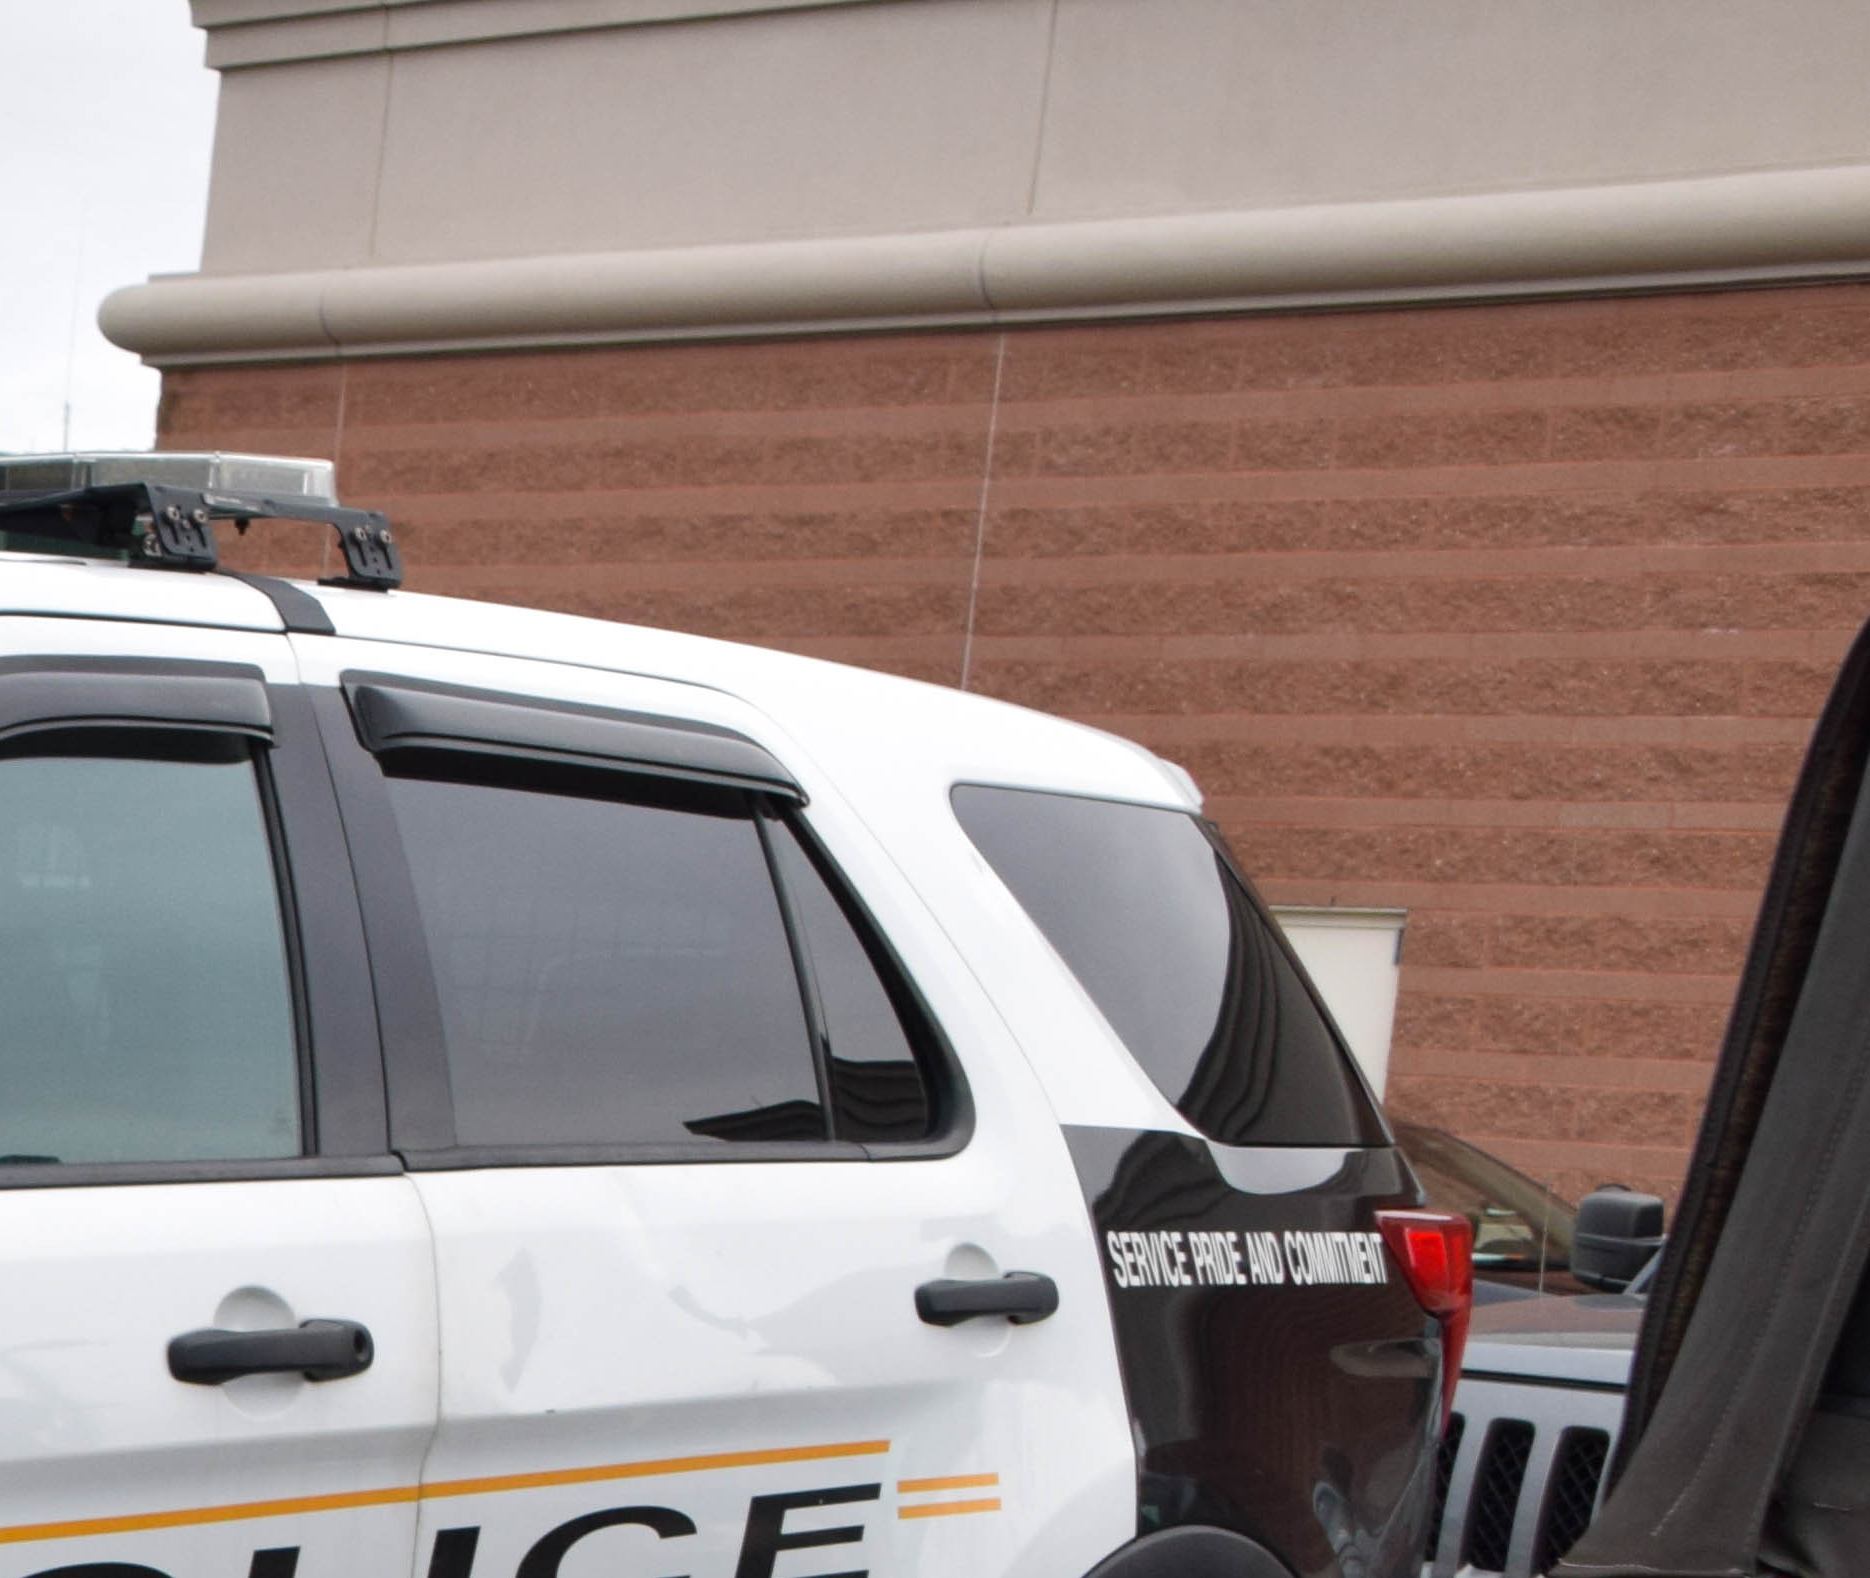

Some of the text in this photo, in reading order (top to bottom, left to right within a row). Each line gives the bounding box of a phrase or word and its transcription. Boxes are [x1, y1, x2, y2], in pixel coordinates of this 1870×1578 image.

[1108, 1231, 1388, 1287] SERVICE PRIDE AND COMMITMENT
